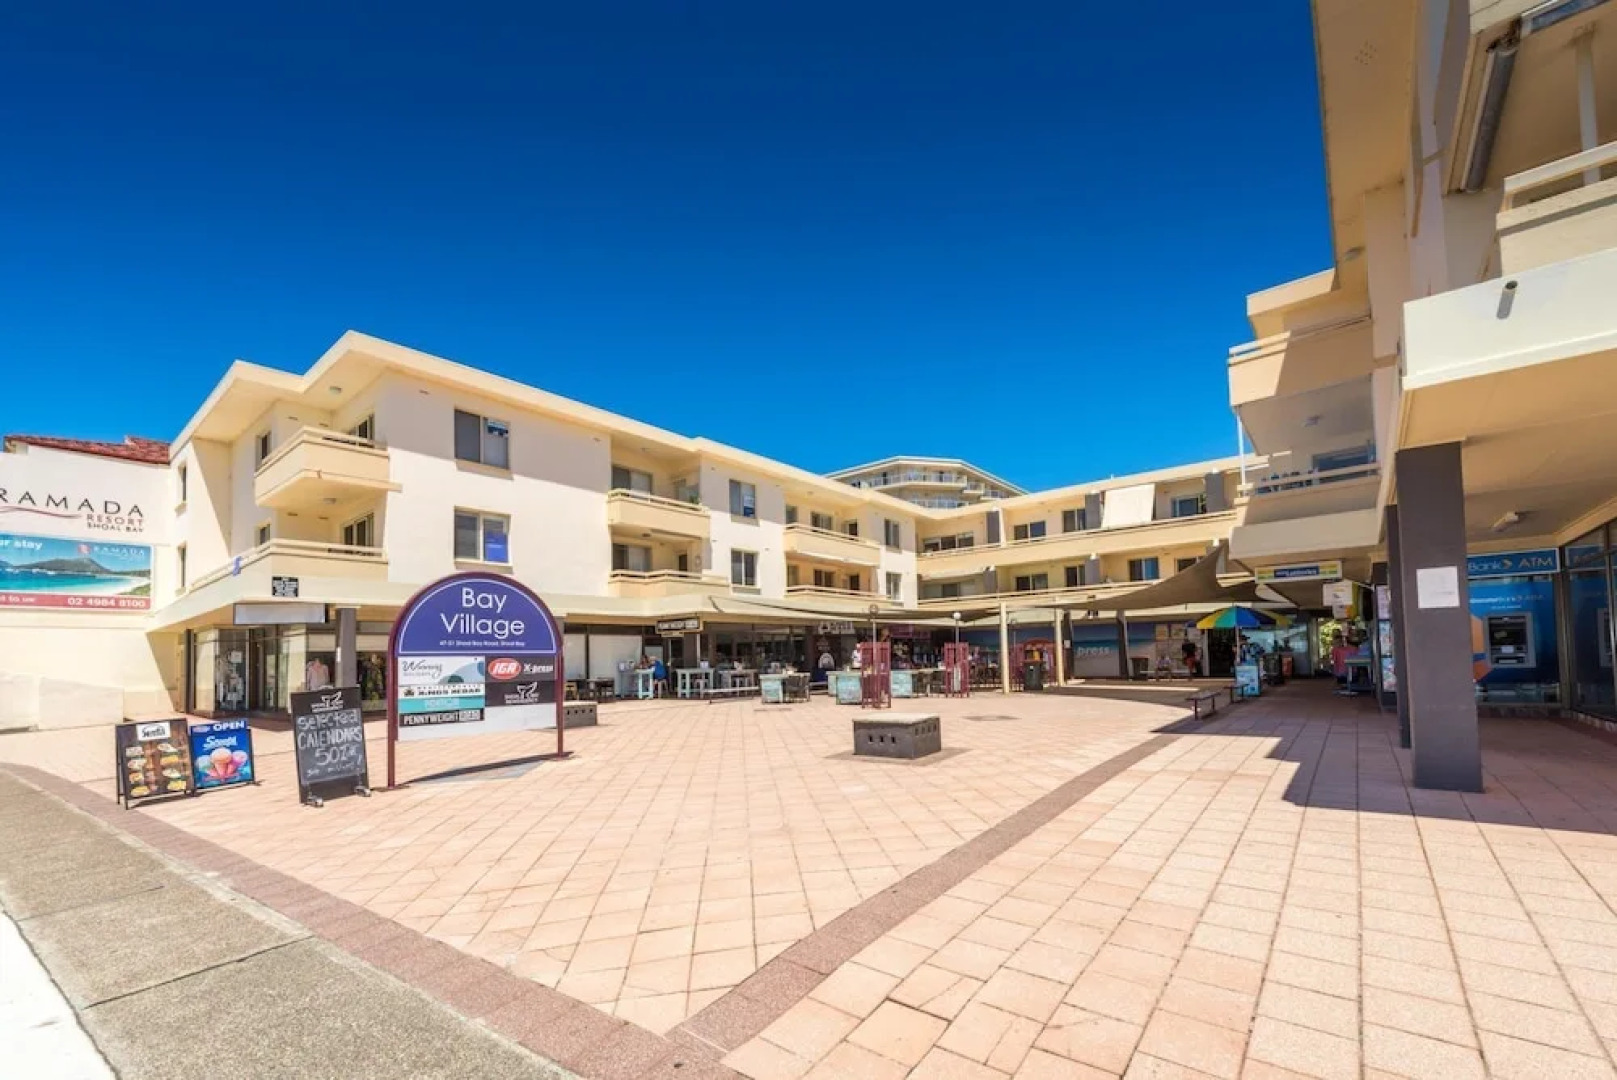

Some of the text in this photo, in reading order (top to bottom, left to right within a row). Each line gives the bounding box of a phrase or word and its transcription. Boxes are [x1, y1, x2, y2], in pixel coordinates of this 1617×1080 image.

[87, 514, 145, 526] RESORT
[87, 522, 121, 532] SHOAL
[13, 540, 42, 551] stay
[94, 546, 145, 555] RAMADA
[1518, 556, 1553, 568] ATM
[67, 597, 146, 608] 02 4984 8100
[462, 587, 507, 613] Bay
[440, 613, 525, 639] Village
[492, 662, 517, 675] IGA
[213, 720, 245, 731] OPEN
